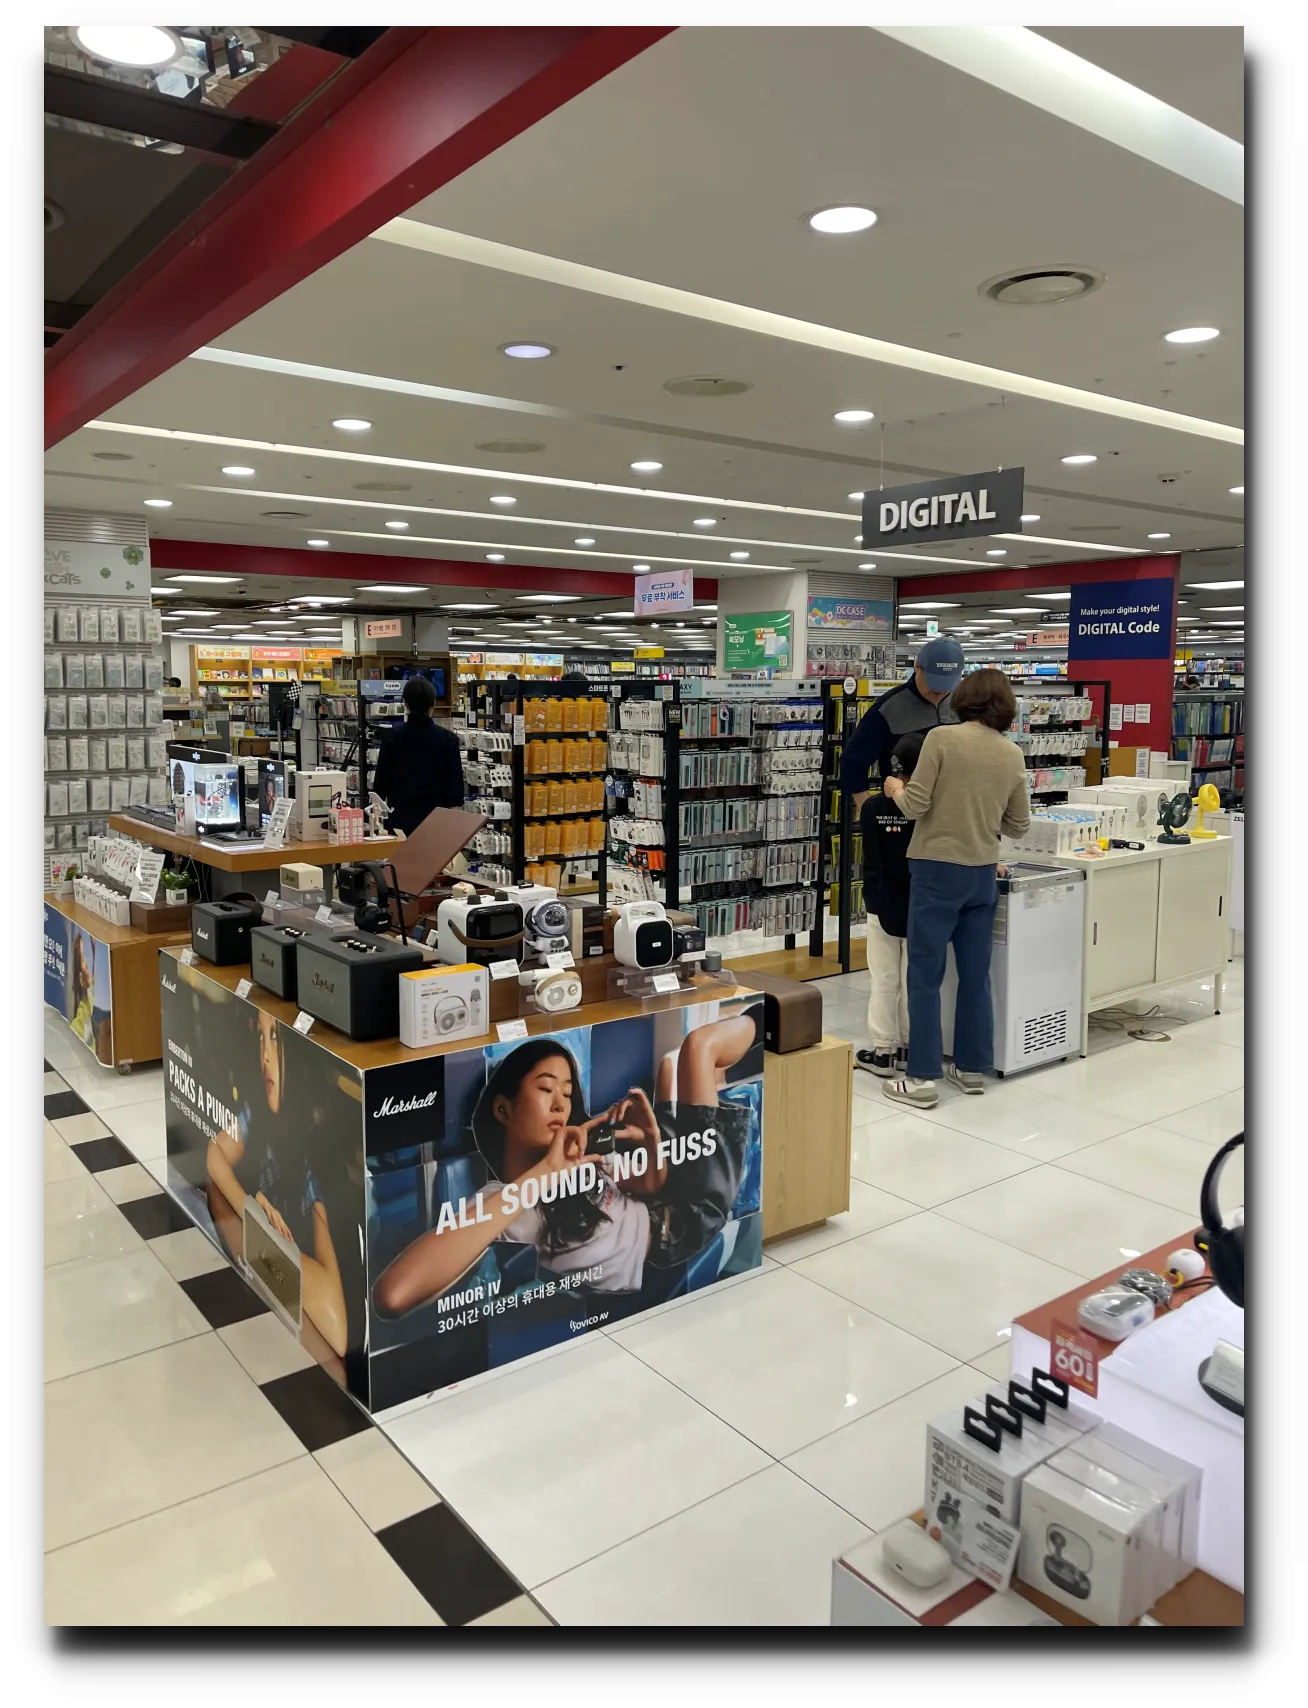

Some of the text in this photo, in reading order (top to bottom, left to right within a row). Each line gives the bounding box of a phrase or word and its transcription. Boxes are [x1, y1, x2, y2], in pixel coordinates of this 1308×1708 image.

[879, 488, 996, 532] DIGITAL
[641, 589, 685, 604] 무료 부착 서비스
[1080, 607, 1099, 616] Make
[1099, 608, 1116, 617] your
[1116, 605, 1139, 615] digital
[1140, 604, 1160, 614] style!
[1032, 633, 1038, 644] E
[1078, 620, 1160, 636] DIGITAL Code
[169, 1059, 238, 1143] PACKS A PUNCH
[373, 1091, 436, 1119] Marshall
[435, 1128, 717, 1235] ALL SOUND, NO FUSS
[437, 1279, 501, 1314] MINOR IV
[437, 1265, 604, 1334] 30시간 이상의 휴대용 재생시간
[598, 1311, 609, 1324] AV
